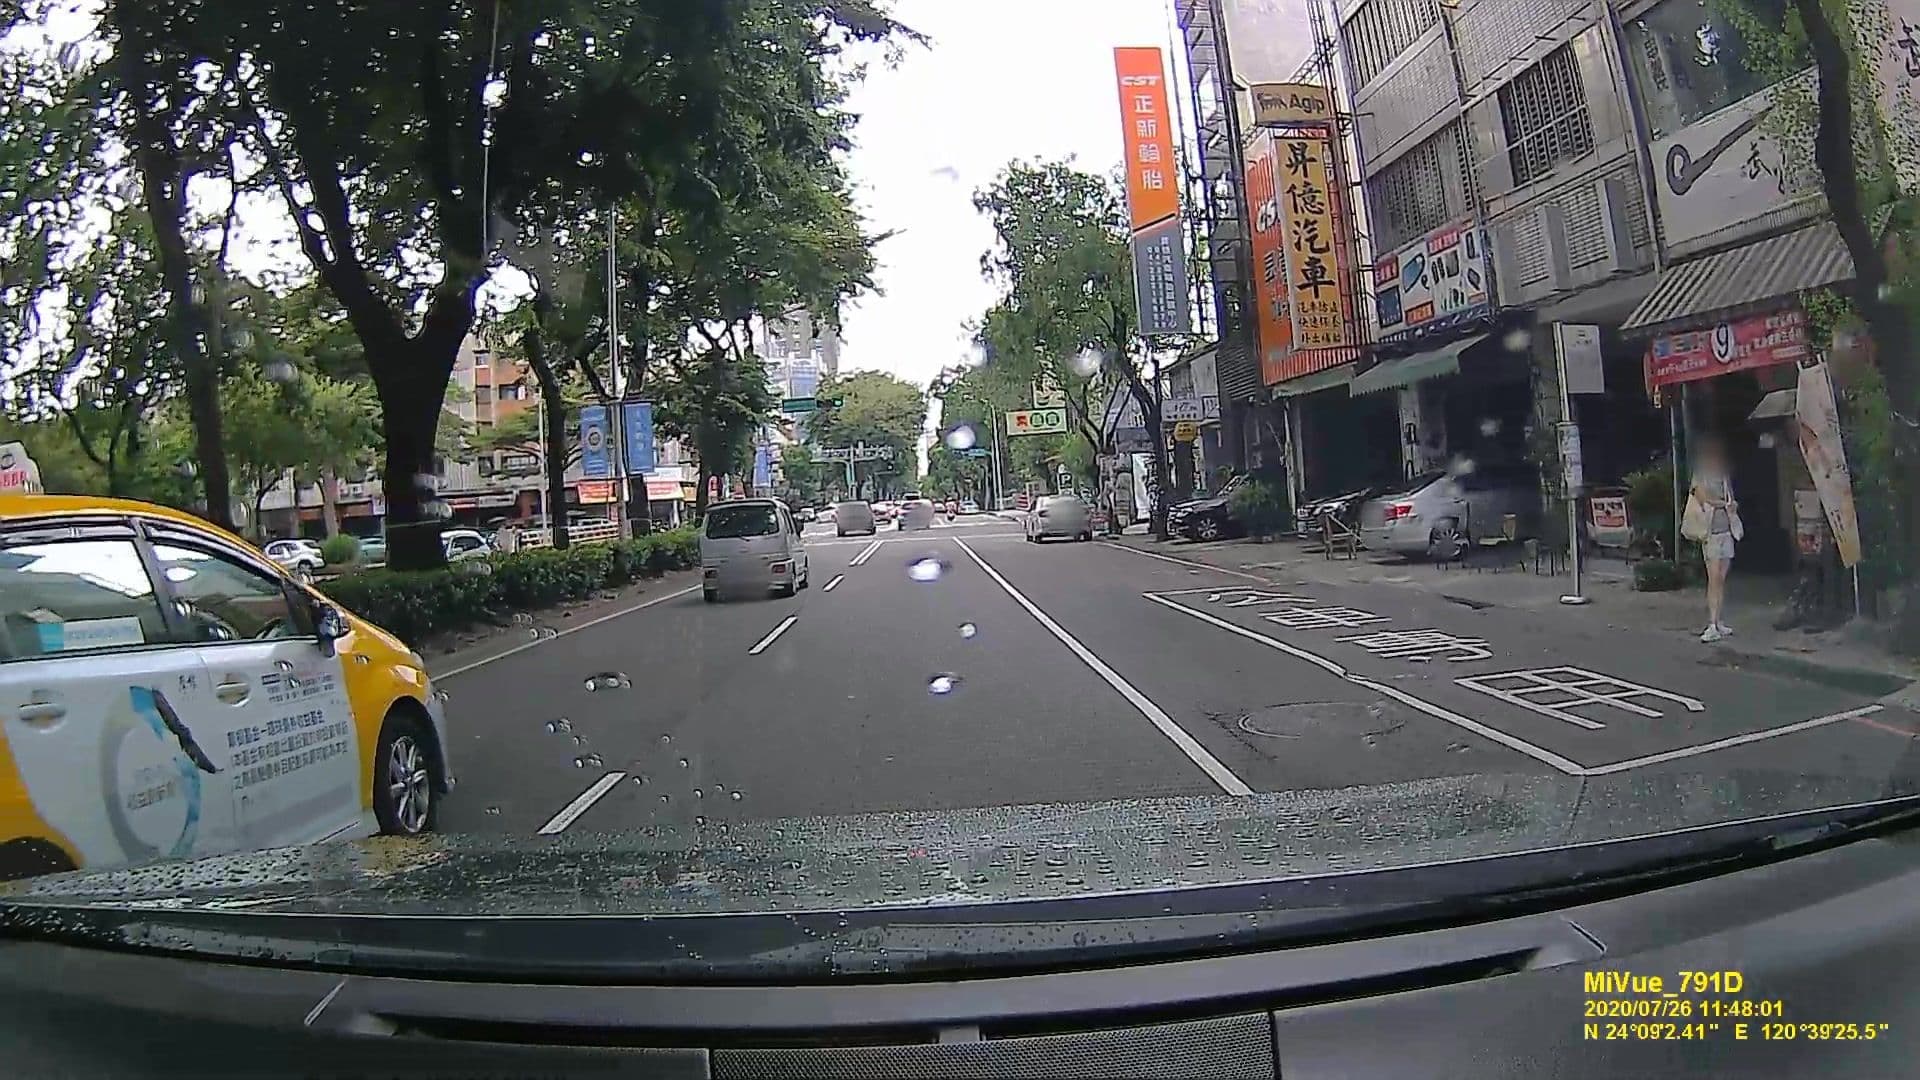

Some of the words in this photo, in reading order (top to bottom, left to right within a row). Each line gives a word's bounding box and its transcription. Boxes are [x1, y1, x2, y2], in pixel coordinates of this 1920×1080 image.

[1120, 76, 1160, 86] CST
[1134, 95, 1163, 190] 正新輪胎
[1285, 142, 1336, 299] 昇億汽車
